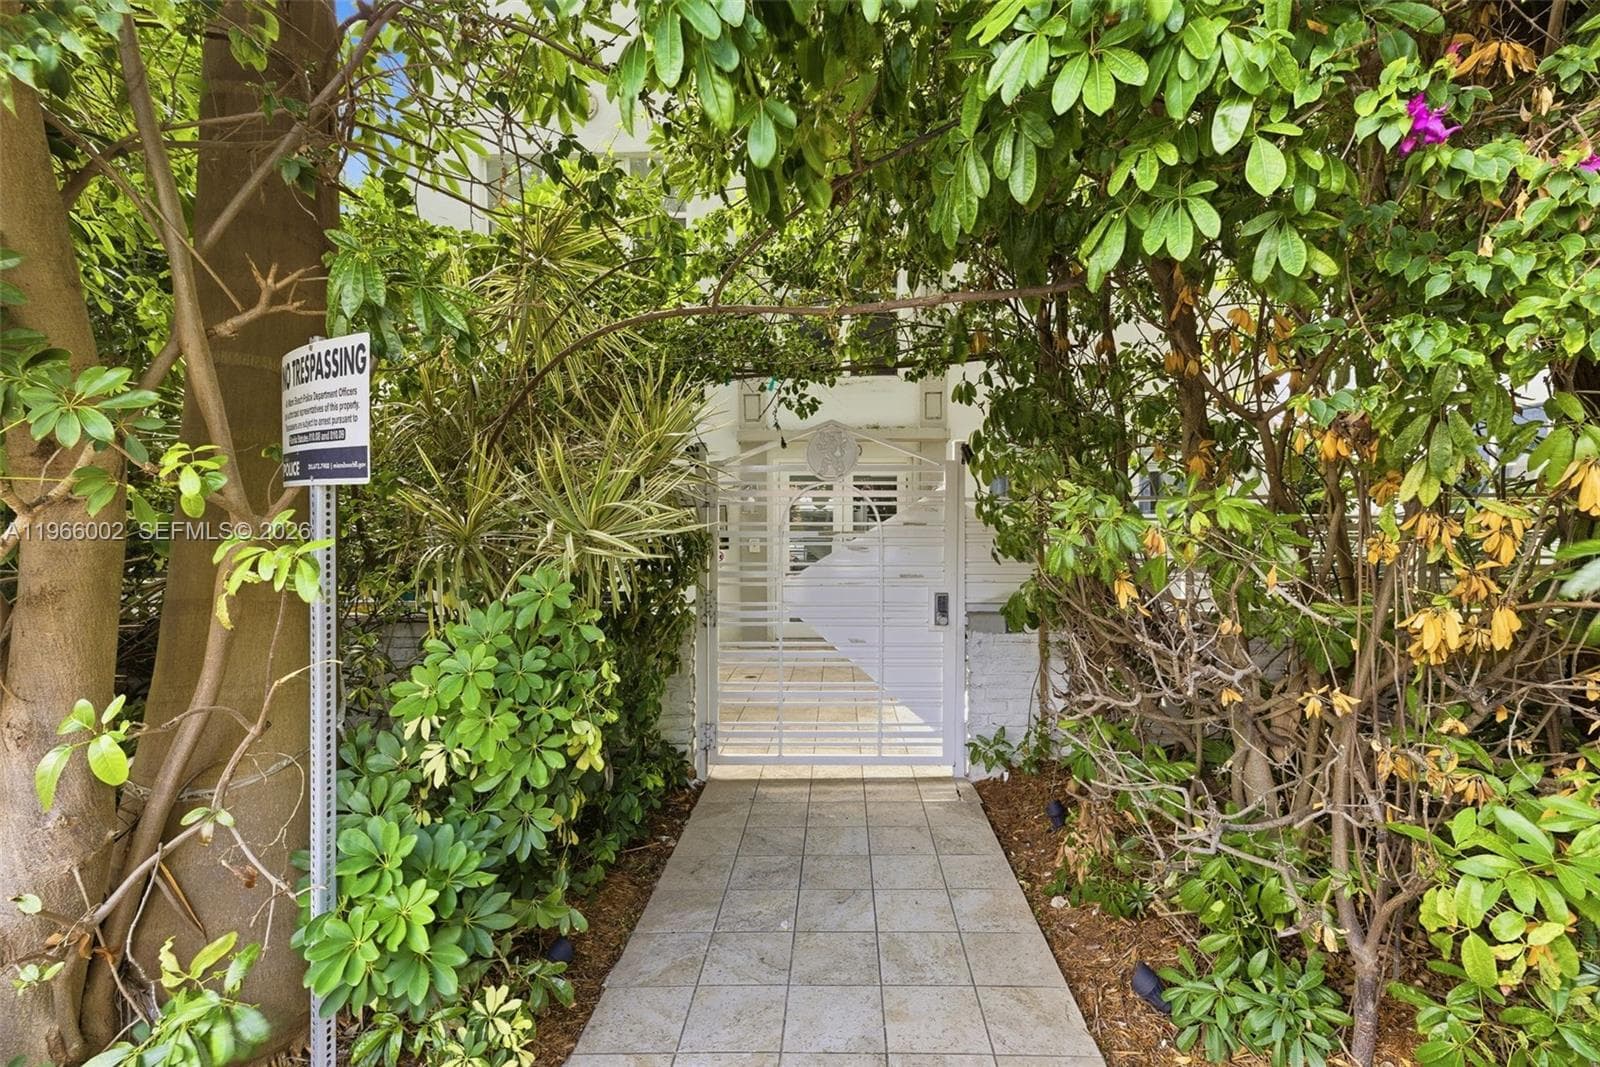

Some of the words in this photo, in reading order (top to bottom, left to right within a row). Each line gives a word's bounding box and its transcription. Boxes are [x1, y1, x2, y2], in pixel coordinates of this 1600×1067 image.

[292, 343, 367, 387] TRESPASSING
[313, 389, 338, 402] Department
[338, 387, 358, 397] Officers
[324, 402, 330, 412] of
[330, 401, 339, 412] this
[331, 415, 353, 426] pursuant
[321, 430, 330, 440] and
